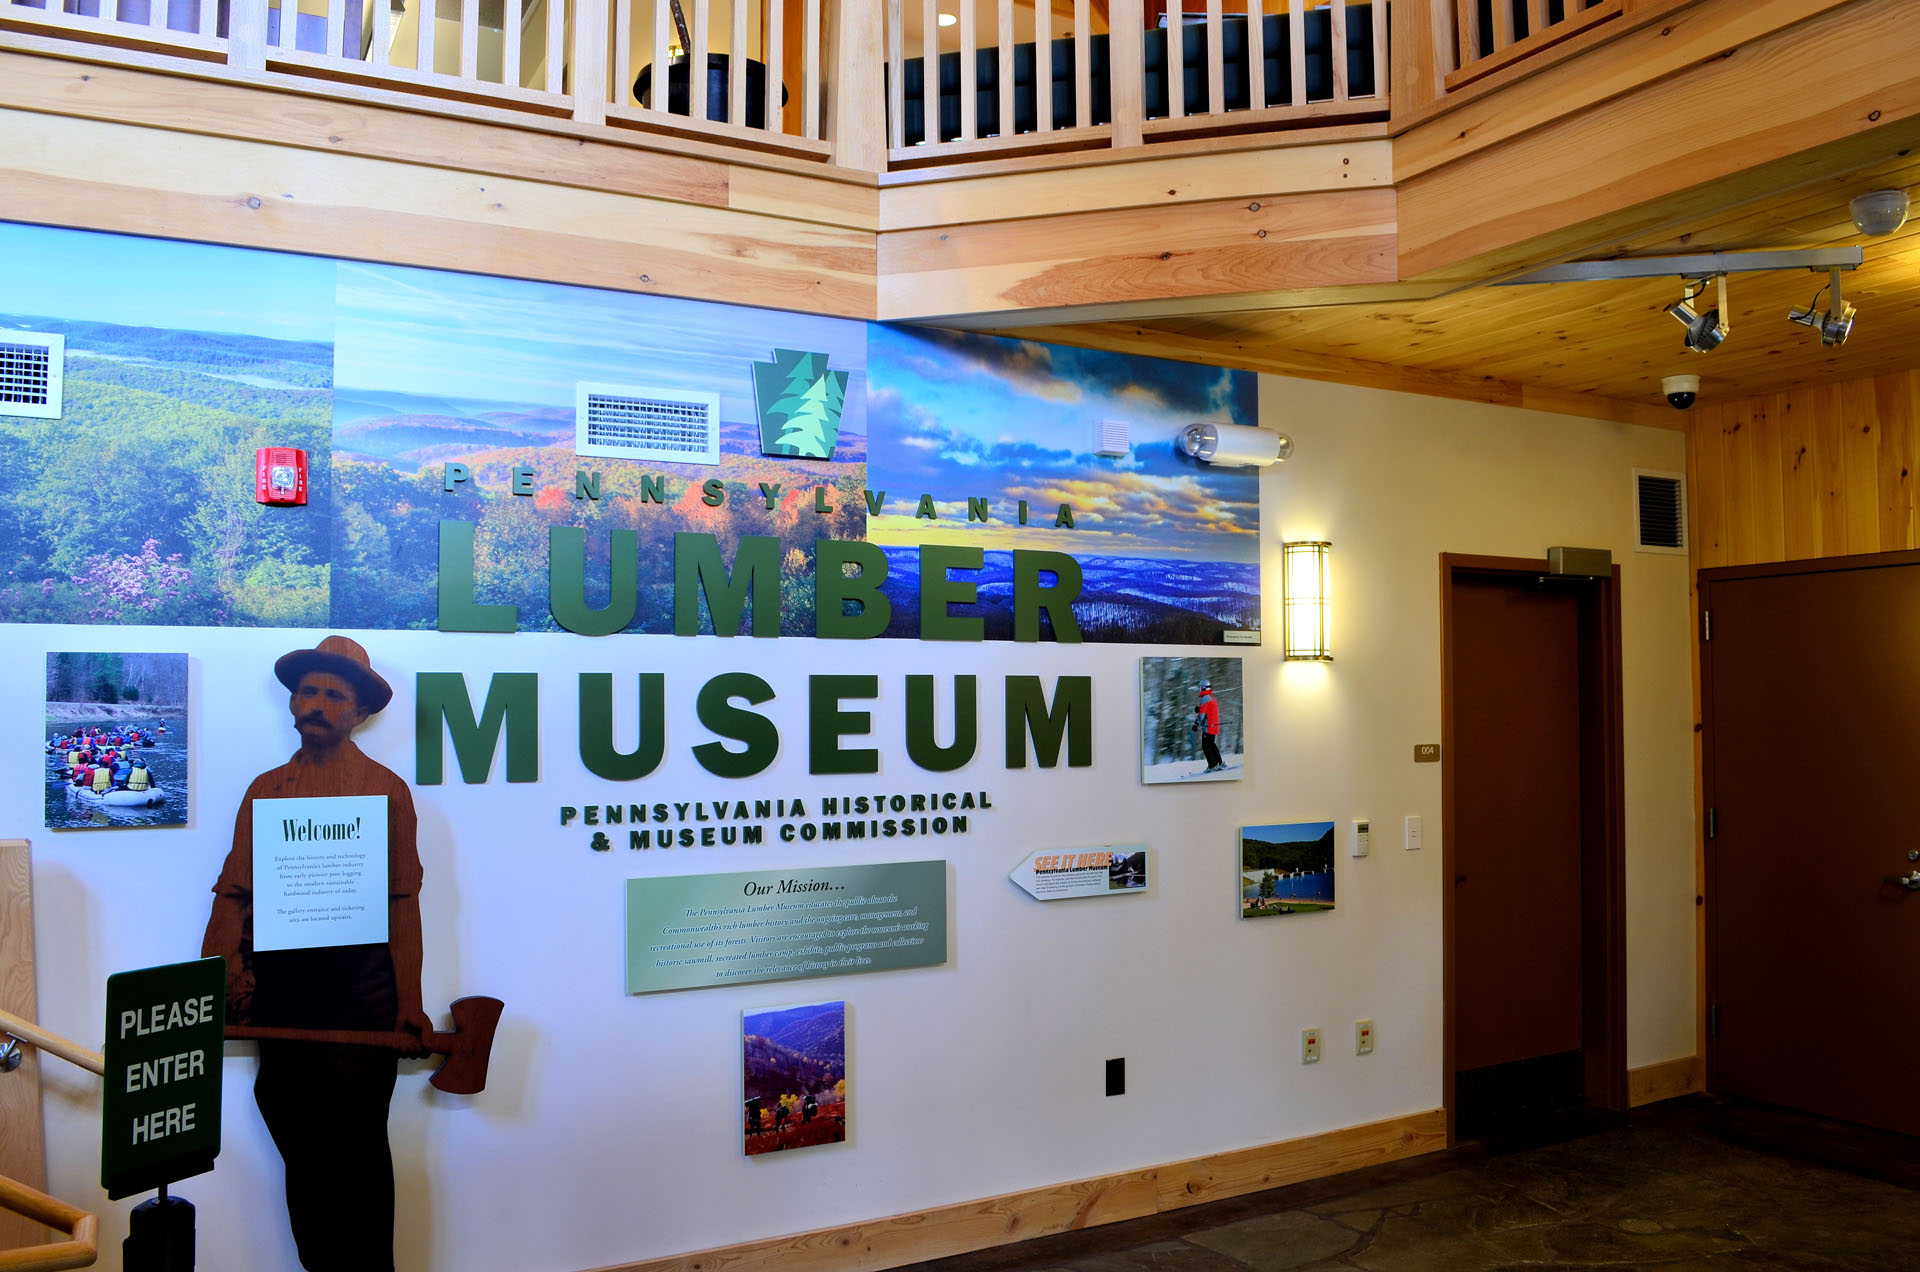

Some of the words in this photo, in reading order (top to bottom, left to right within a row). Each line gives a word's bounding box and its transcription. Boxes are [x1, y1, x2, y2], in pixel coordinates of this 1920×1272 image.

[445, 462, 1075, 528] PENNSYLVANIA
[438, 519, 1083, 643] LUMBER
[416, 672, 1092, 785] MUSEUM
[1421, 746, 1434, 755] 004
[561, 798, 805, 826] PENNSYLVANIA
[822, 791, 992, 815] HISTORICAL
[282, 817, 361, 842] Welcome!
[591, 832, 610, 851] &
[630, 825, 763, 850] MUSEUM
[780, 815, 968, 842] COMMISSION
[1033, 855, 1060, 872] SEE
[1061, 853, 1076, 869] IT
[1077, 851, 1115, 868] HERE
[743, 881, 773, 896] Our
[776, 879, 845, 894] Mission...
[288, 907, 305, 915] gallery
[686, 908, 698, 917] The
[700, 906, 745, 918] Pennsylvania
[747, 903, 774, 913] Lumber
[776, 902, 804, 911] Museum
[806, 899, 833, 909] educates
[834, 897, 845, 906] the
[845, 895, 866, 908] public
[867, 895, 887, 905] about
[887, 894, 899, 903] the
[662, 923, 722, 935] Commonwealth's
[723, 921, 737, 930] rich
[739, 919, 763, 929] lumber
[765, 919, 788, 928] history
[790, 916, 804, 925] and
[805, 915, 815, 924] the
[816, 915, 842, 925] ongoing
[904, 907, 918, 916] and
[649, 940, 693, 952] recreational
[706, 938, 716, 949] of
[715, 939, 724, 947] its
[723, 938, 748, 948] forests.
[751, 935, 776, 943] Visitors
[789, 929, 828, 942] encouraged
[828, 930, 835, 938] to
[837, 926, 860, 939] explore
[860, 925, 871, 935] the
[656, 958, 682, 968] historic
[684, 954, 714, 965] sawmill,
[715, 951, 748, 962] recreated
[748, 949, 773, 960] lumber
[774, 949, 793, 958] camp,
[825, 942, 846, 955] public
[879, 937, 892, 948] and
[724, 967, 753, 977] discover
[754, 964, 765, 974] the
[766, 963, 798, 974] relevance
[798, 961, 806, 973] of
[805, 960, 829, 971] history
[830, 959, 839, 968] in
[120, 994, 214, 1040] PLEASE
[126, 1049, 205, 1094] ENTER
[132, 1102, 196, 1146] HERE
